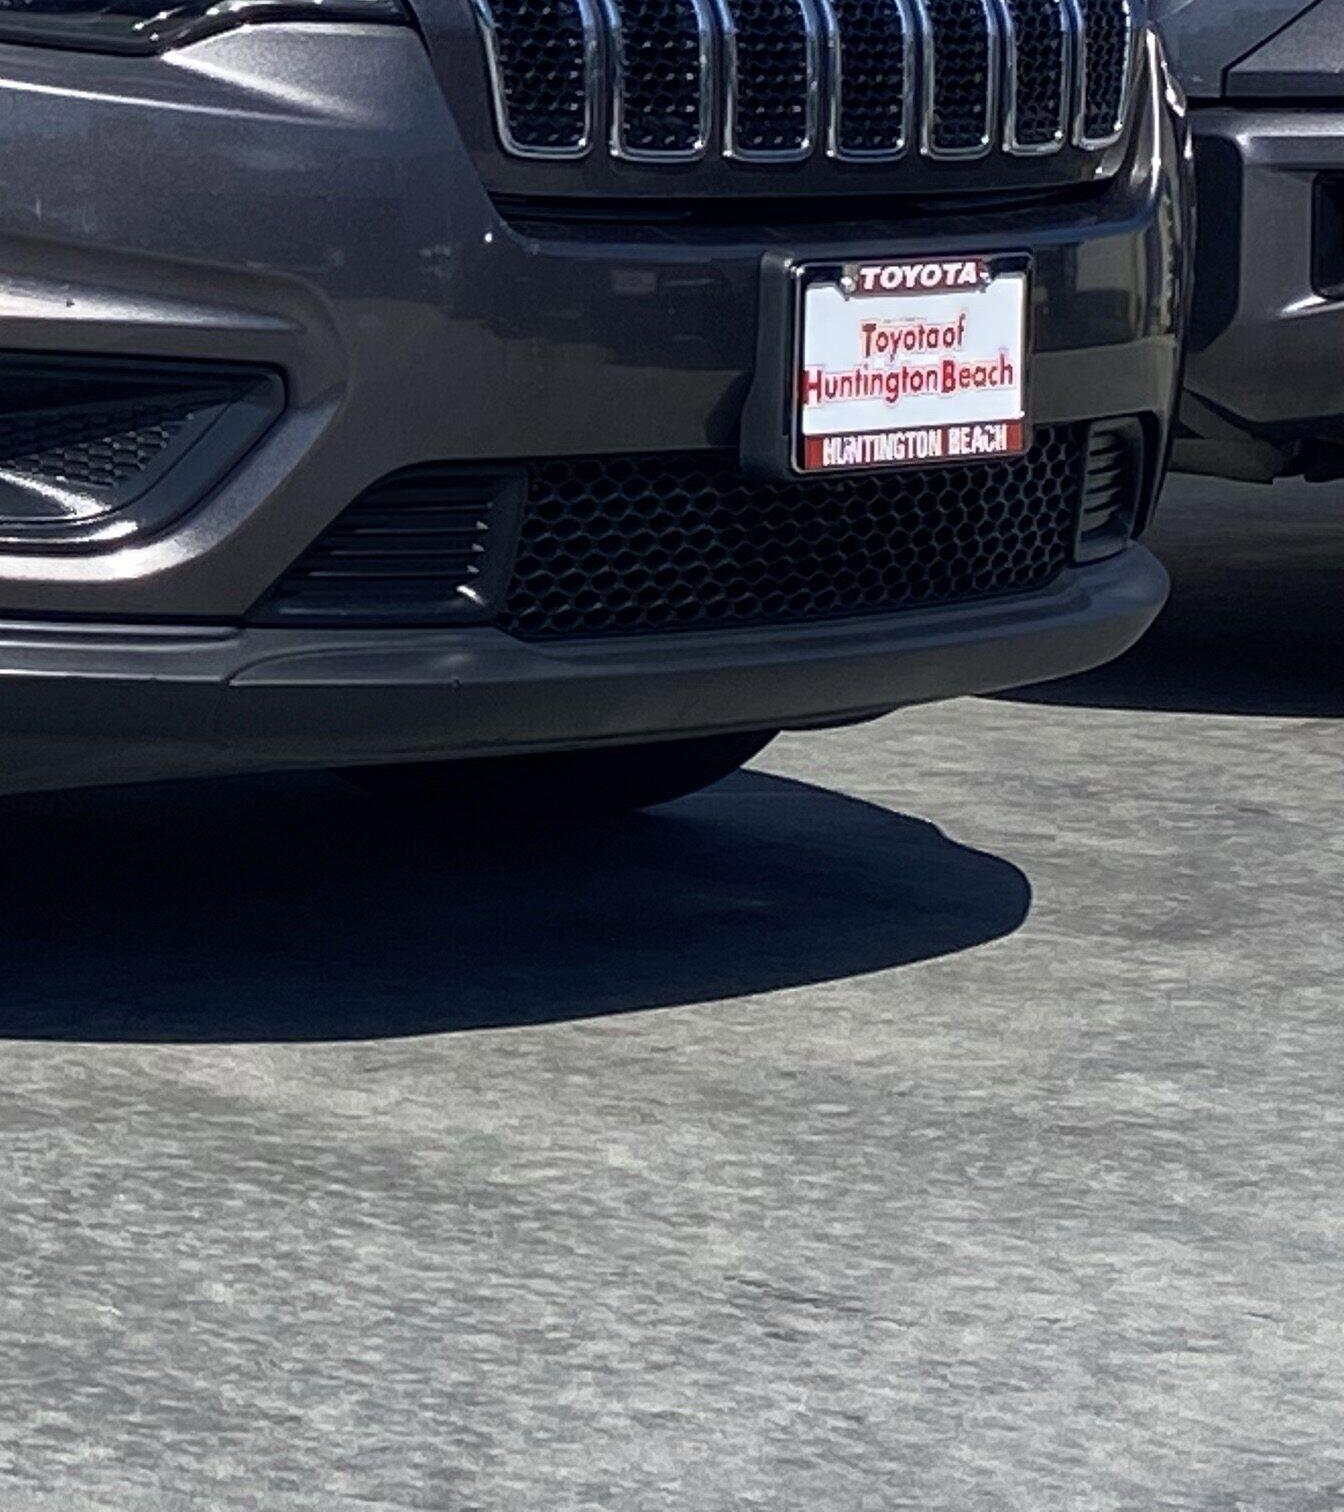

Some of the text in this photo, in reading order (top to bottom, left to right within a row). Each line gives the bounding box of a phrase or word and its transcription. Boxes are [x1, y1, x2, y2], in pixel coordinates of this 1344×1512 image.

[861, 261, 977, 290] TOYOTA
[862, 313, 967, 362] Toyota of
[802, 350, 1014, 405] Huntington Beach
[822, 422, 1008, 466] HUNTINGTON BEACH
